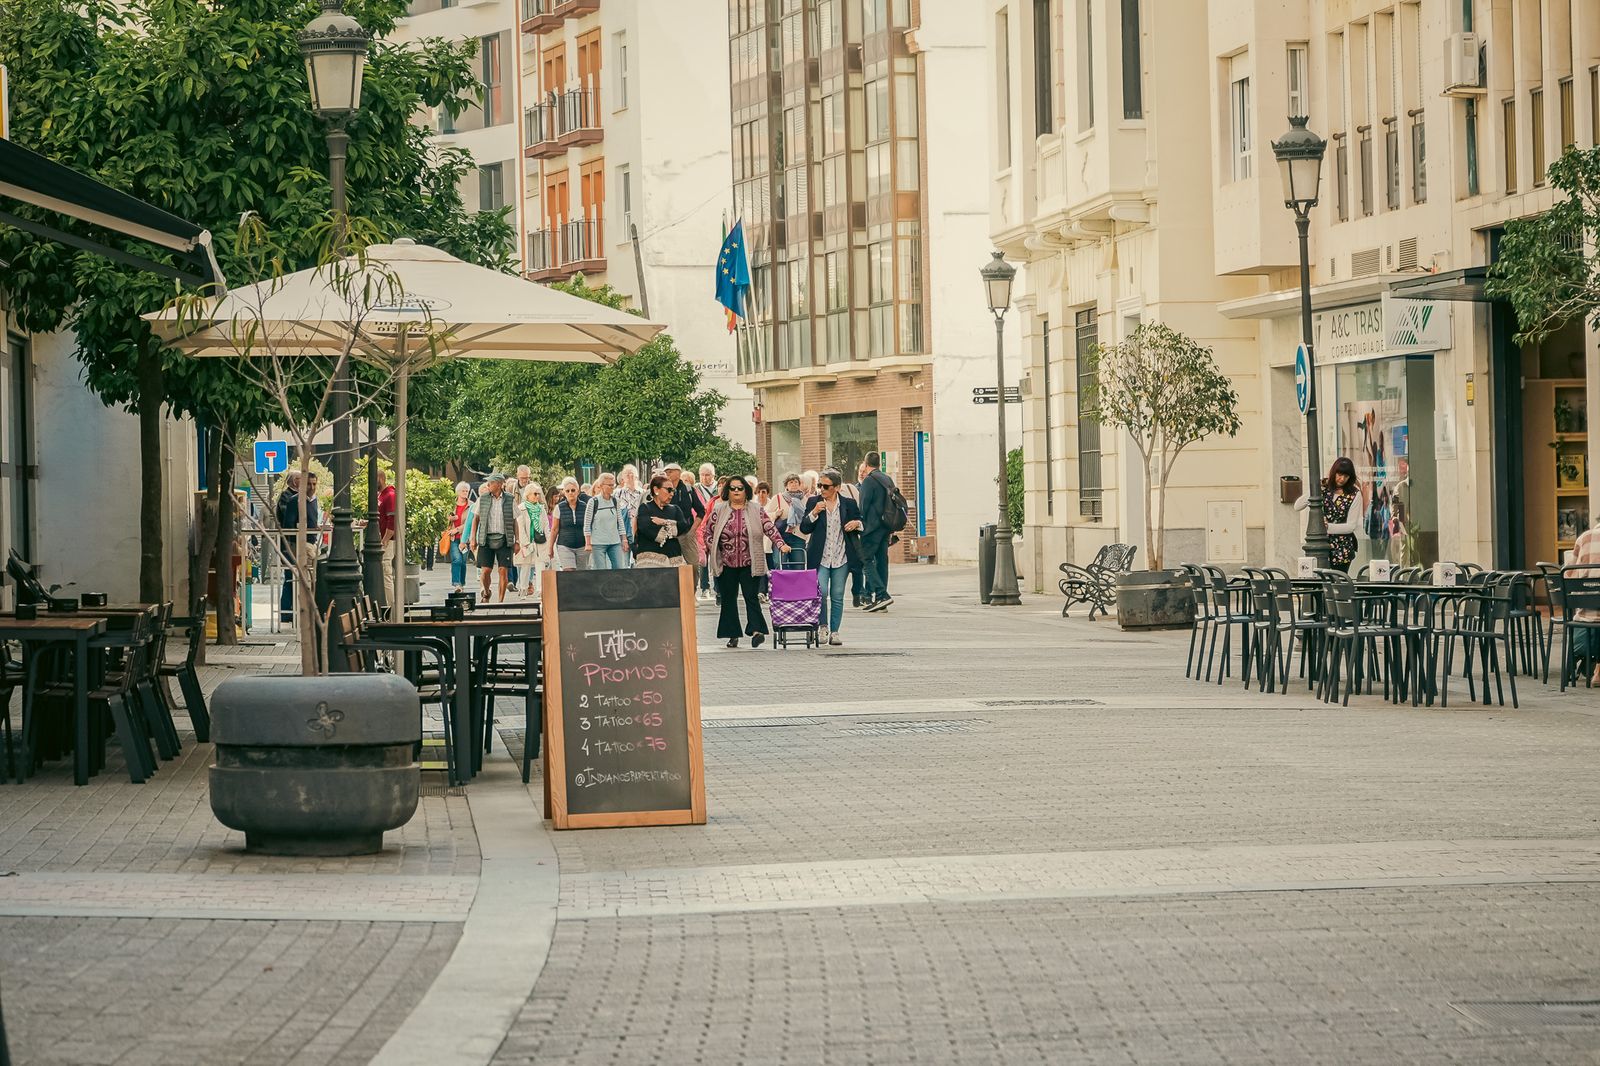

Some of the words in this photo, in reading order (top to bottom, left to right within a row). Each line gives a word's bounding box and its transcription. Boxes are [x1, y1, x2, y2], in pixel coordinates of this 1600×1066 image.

[1331, 313, 1351, 339] A&C
[1354, 307, 1383, 336] TRAS
[578, 663, 668, 687] PROMOS
[579, 694, 589, 708] 2
[579, 717, 591, 730] 3
[581, 738, 590, 756] 4
